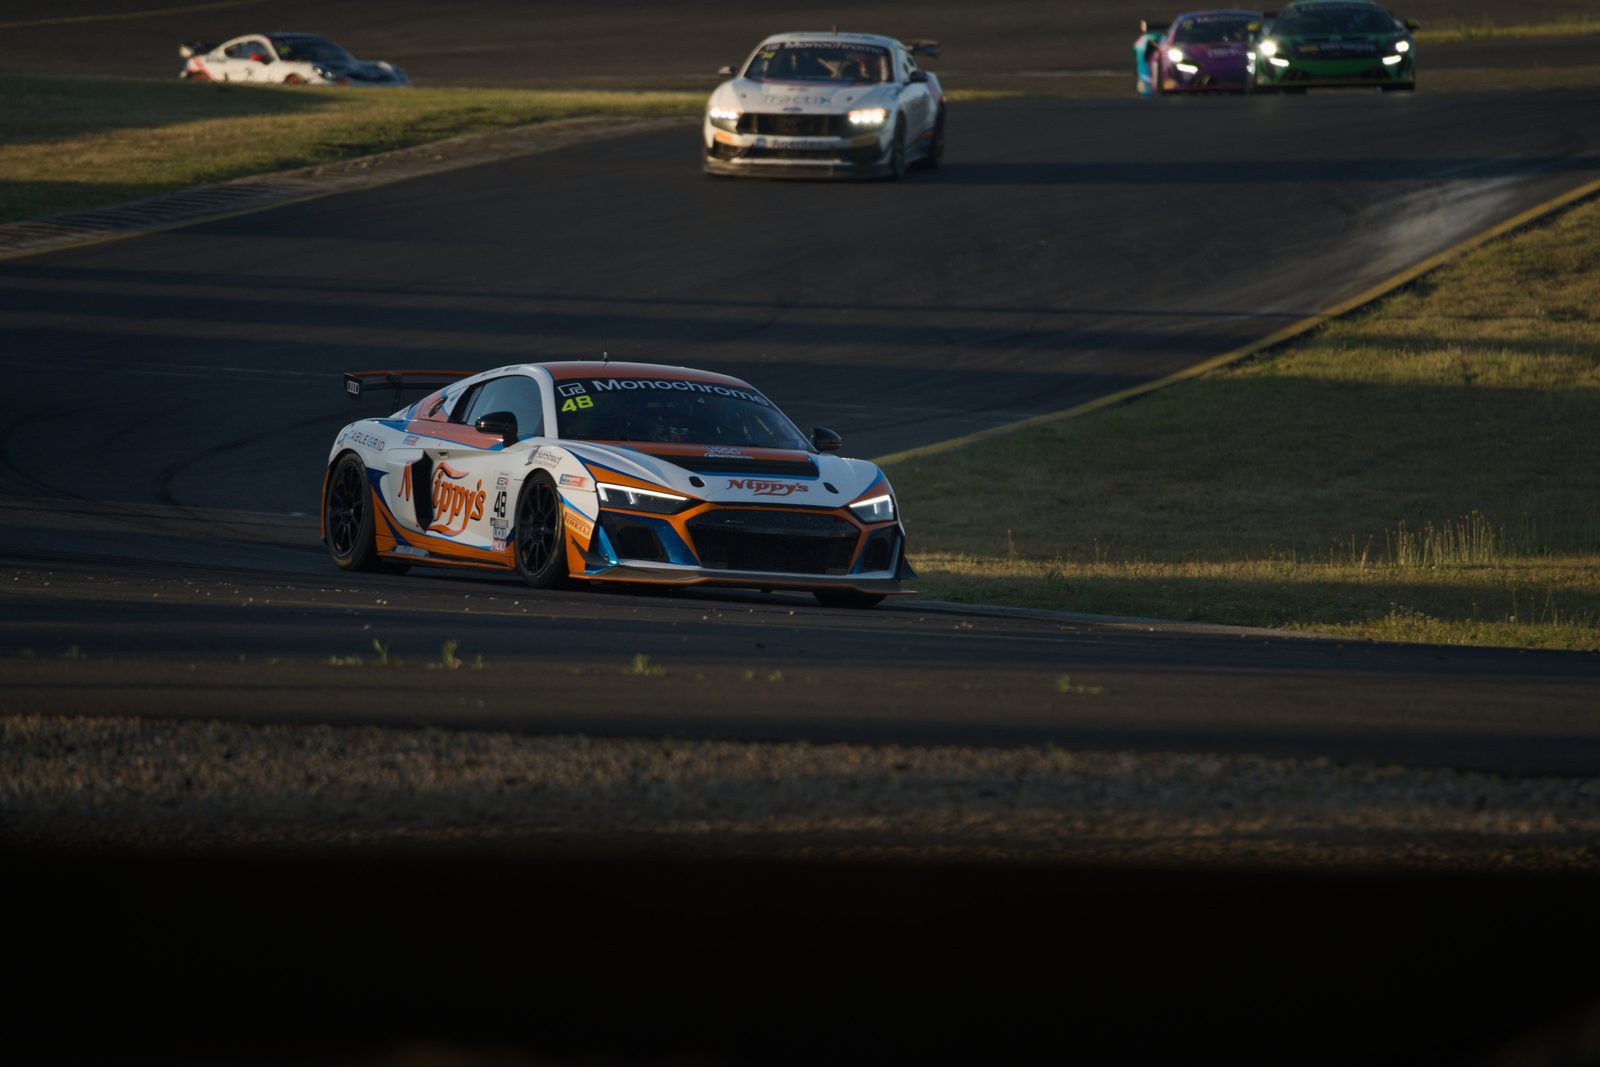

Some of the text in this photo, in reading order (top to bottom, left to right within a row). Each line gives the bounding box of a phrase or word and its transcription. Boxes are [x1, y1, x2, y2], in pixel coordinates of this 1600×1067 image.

[561, 395, 594, 412] 48
[592, 379, 769, 406] Monochrome
[725, 478, 809, 497] Nippy's
[494, 491, 507, 518] 48
